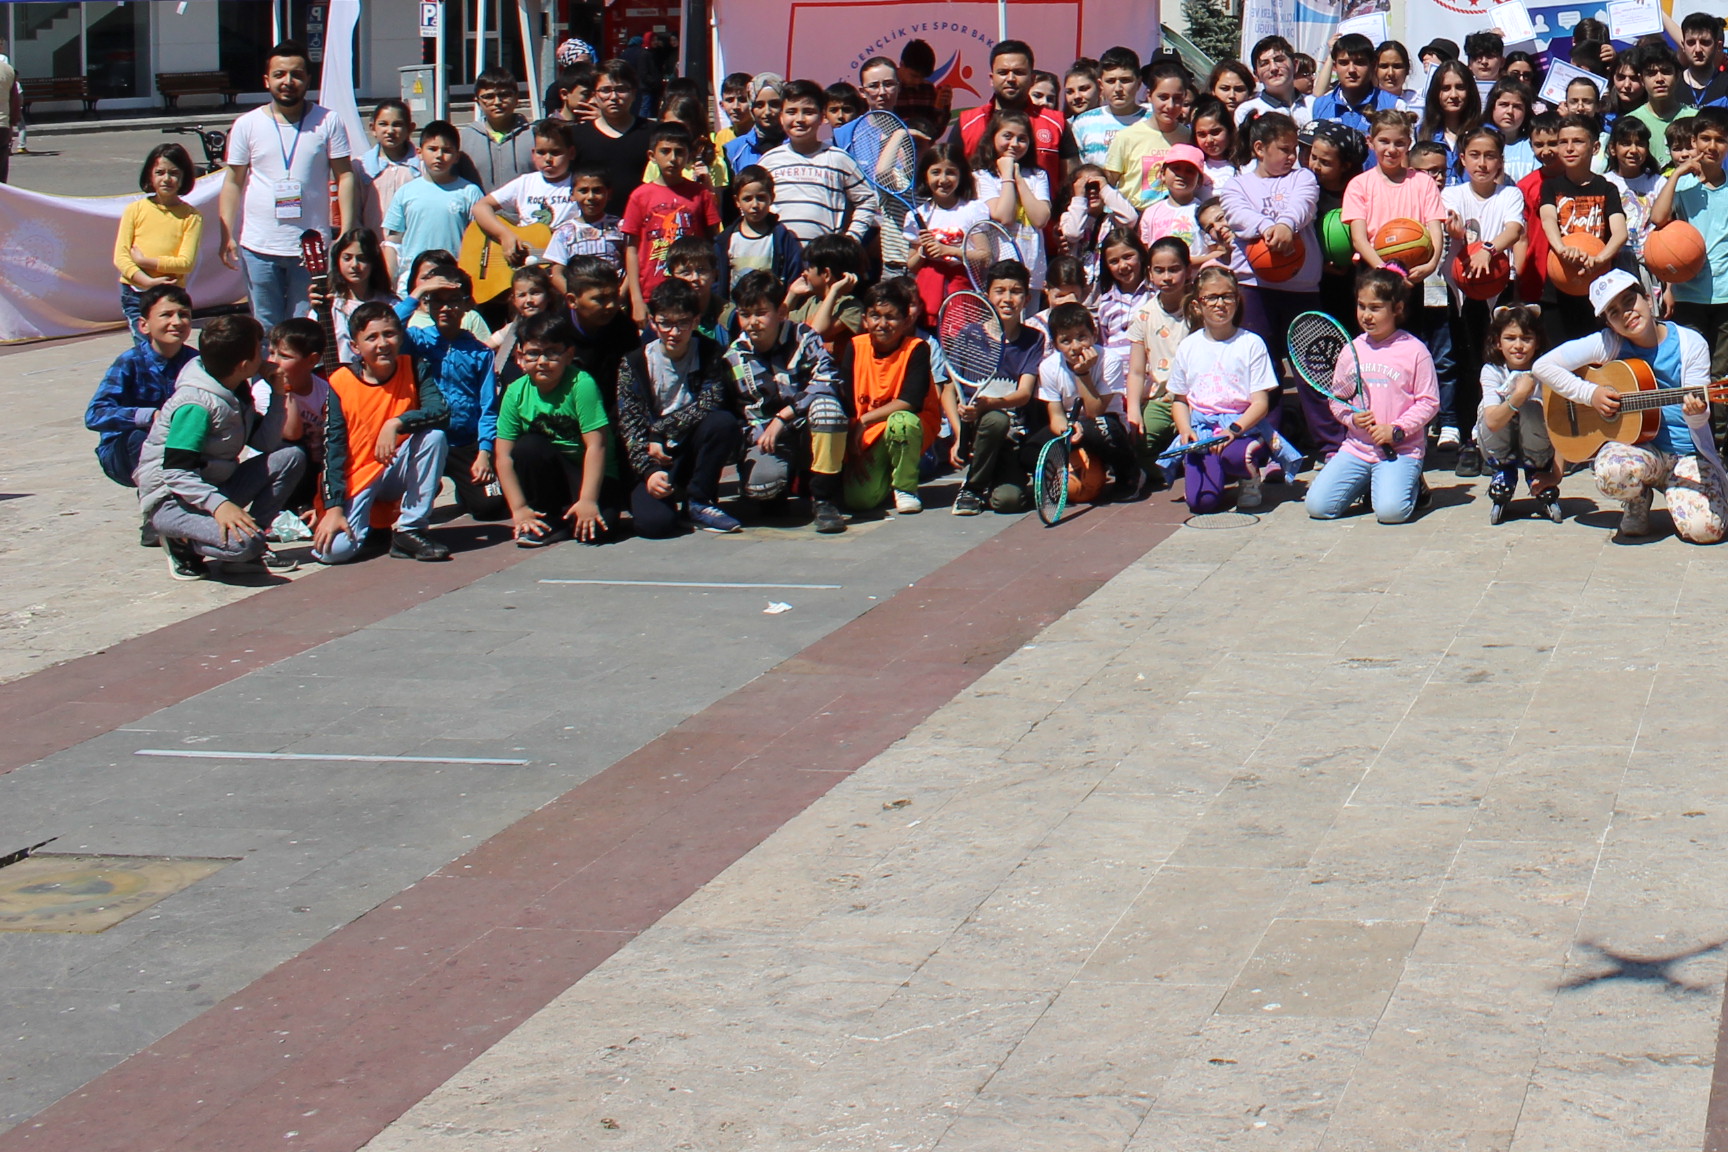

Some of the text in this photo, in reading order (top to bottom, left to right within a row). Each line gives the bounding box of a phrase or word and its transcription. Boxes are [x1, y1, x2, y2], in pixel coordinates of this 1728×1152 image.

[422, 4, 437, 26] P
[850, 21, 995, 70] GENÇLİK VE SPOR BAK
[527, 196, 548, 206] ROCK
[1557, 196, 1602, 237] Quality
